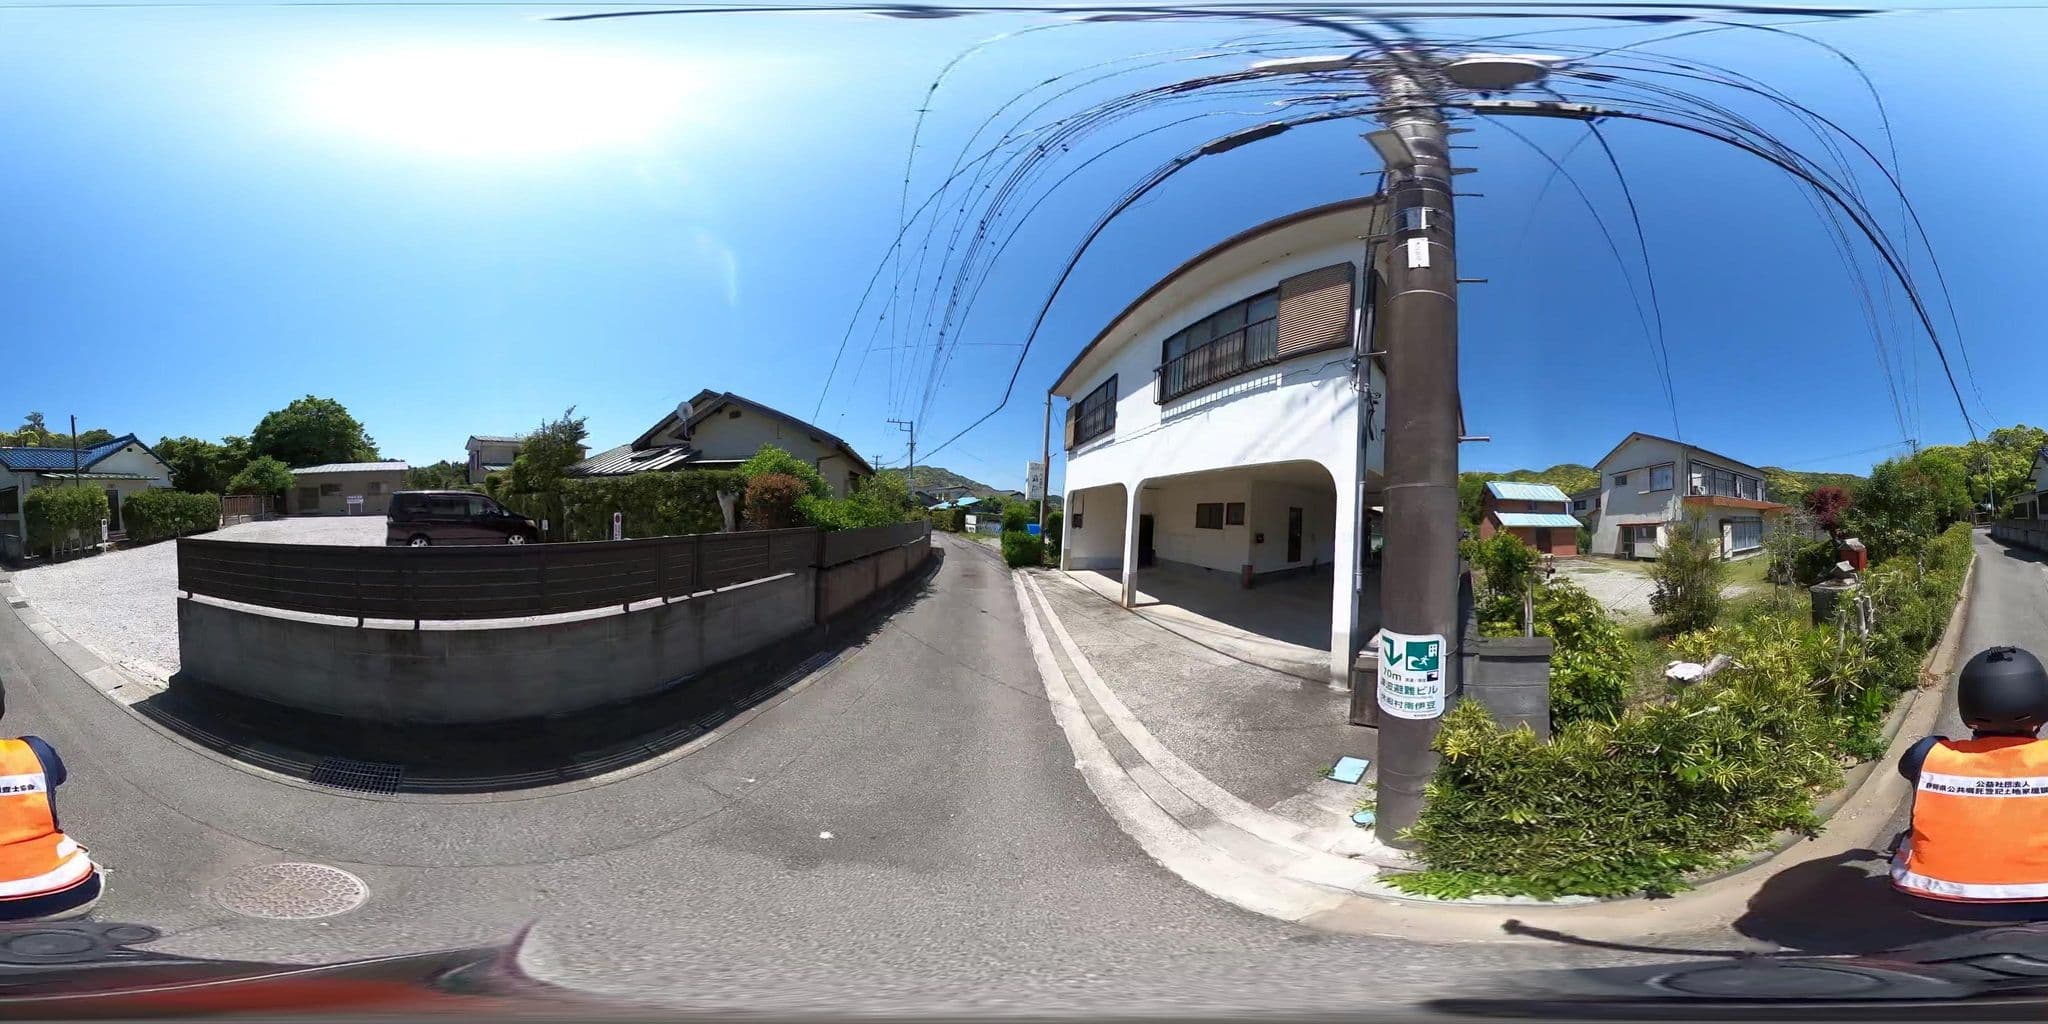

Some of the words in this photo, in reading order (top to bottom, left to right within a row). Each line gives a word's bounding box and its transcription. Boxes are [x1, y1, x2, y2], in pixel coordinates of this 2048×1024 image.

[1976, 780, 2030, 788] 公益社団法人
